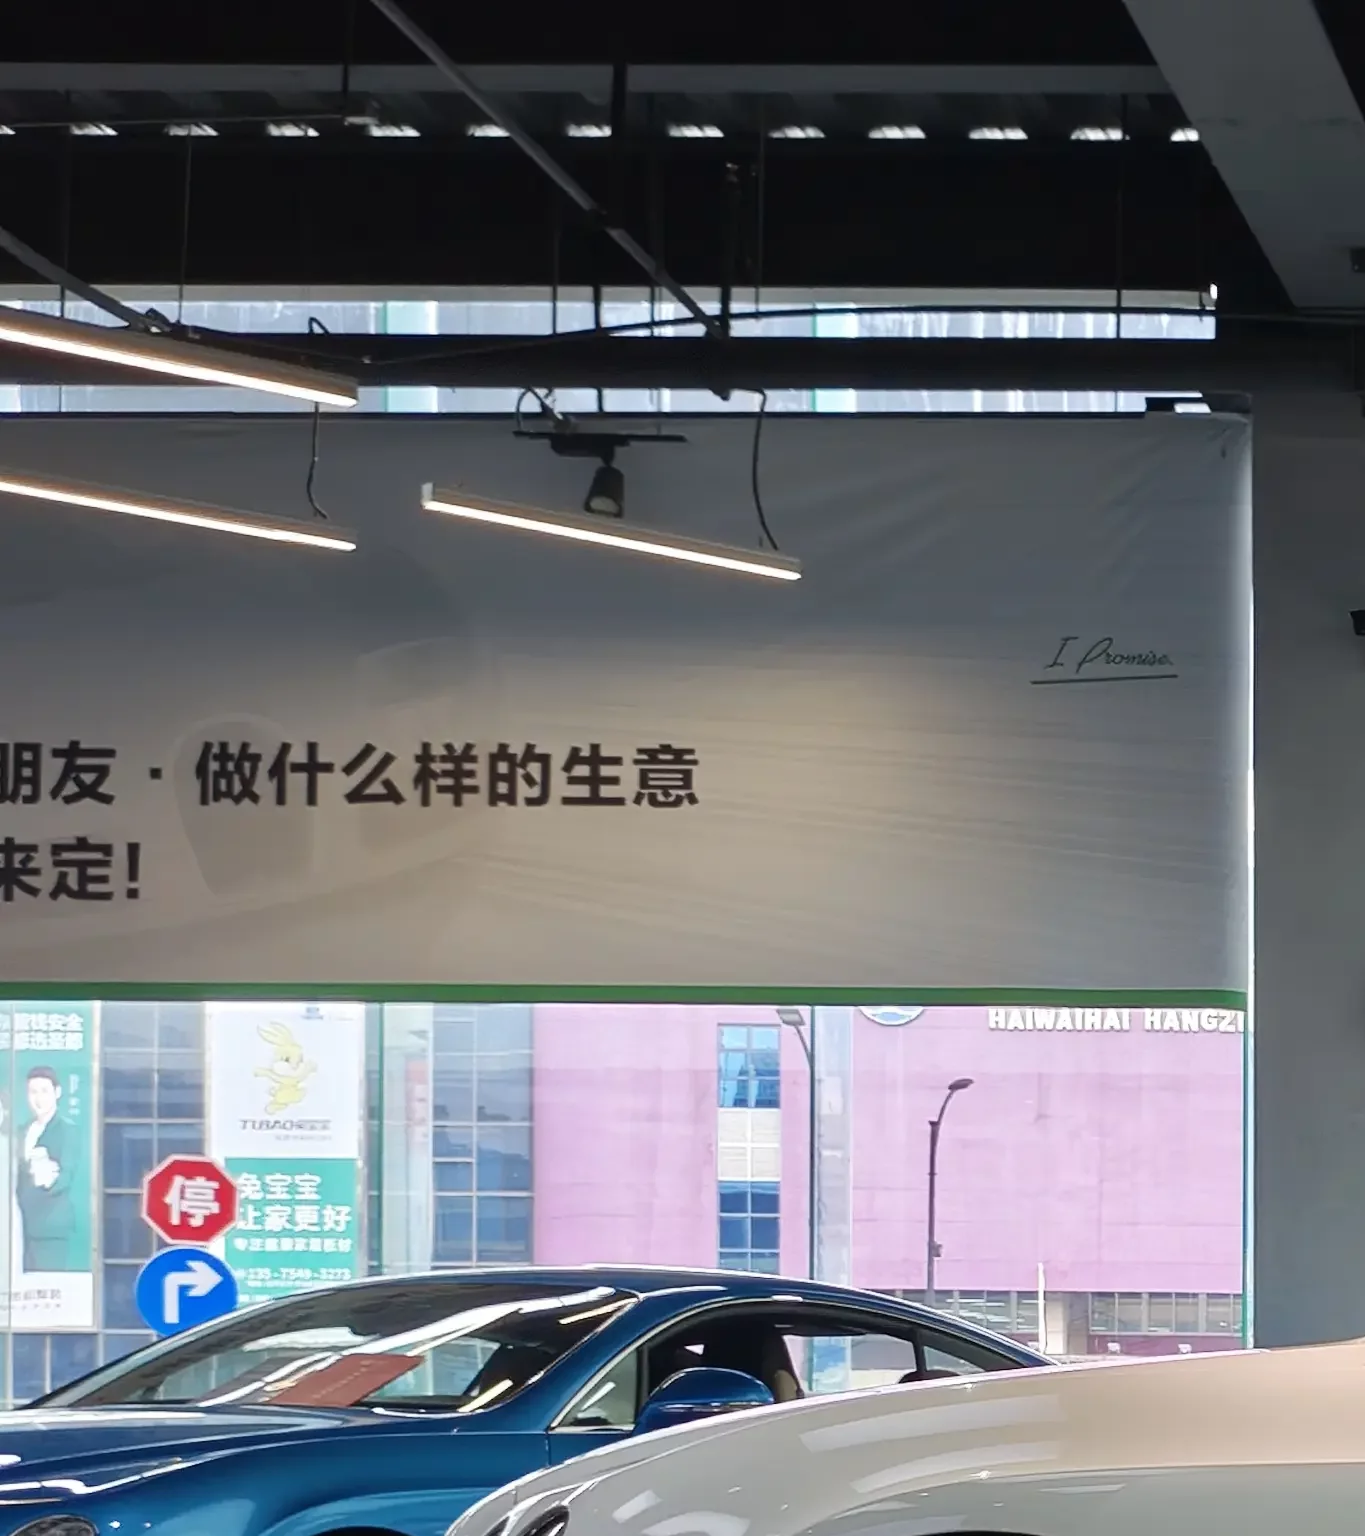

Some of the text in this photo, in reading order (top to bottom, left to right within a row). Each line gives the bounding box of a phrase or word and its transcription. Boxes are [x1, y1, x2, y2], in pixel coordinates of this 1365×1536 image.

[1044, 637, 1175, 674] I Promise
[988, 1007, 1131, 1032] HAIWAIHAI
[163, 1175, 220, 1227] 停
